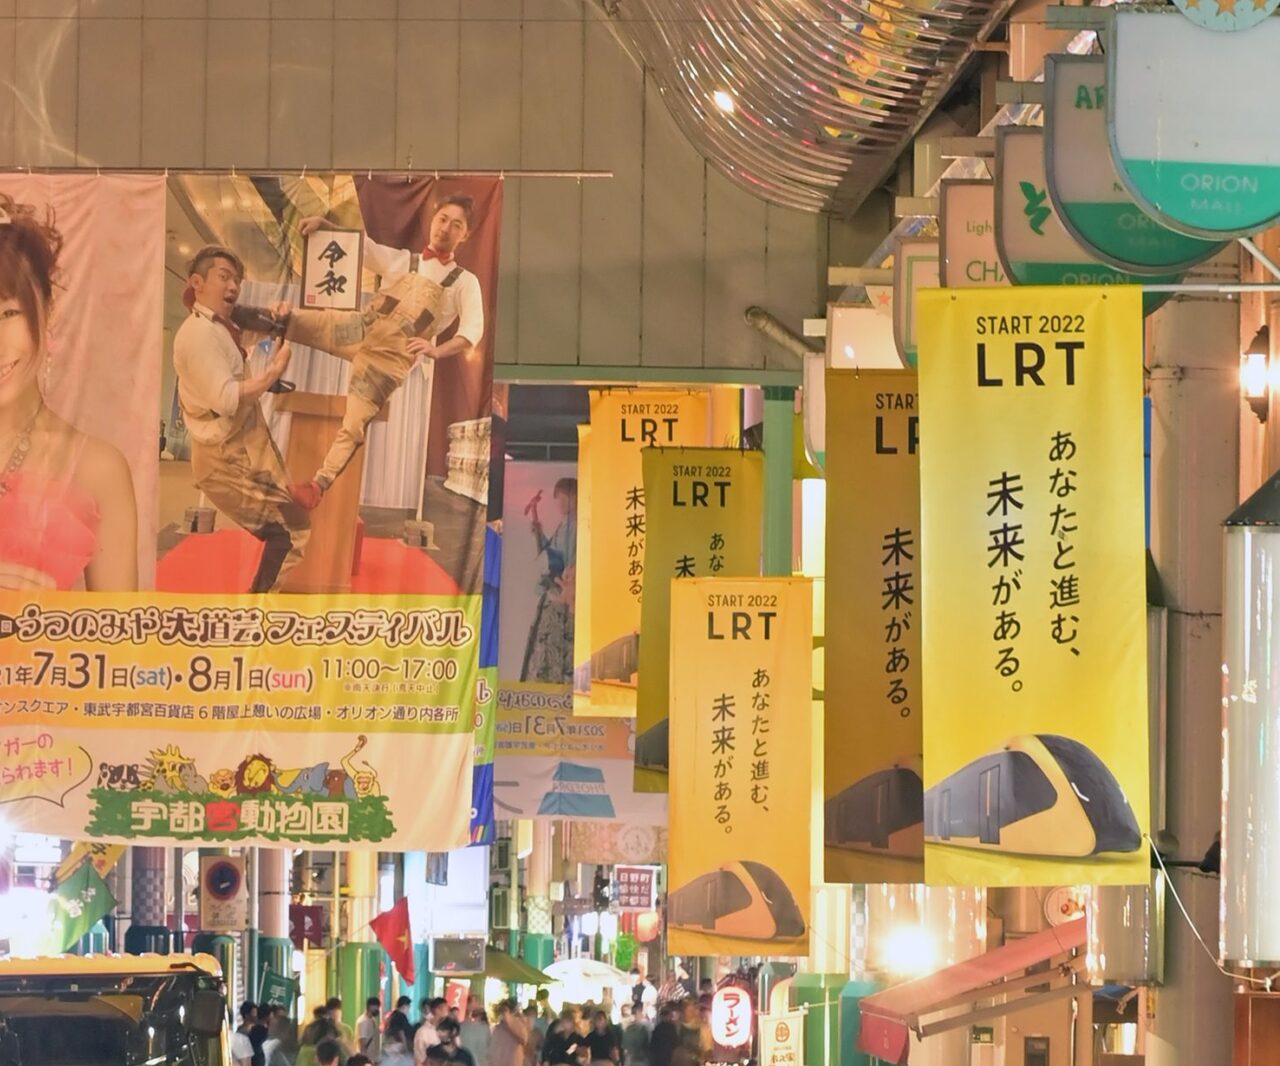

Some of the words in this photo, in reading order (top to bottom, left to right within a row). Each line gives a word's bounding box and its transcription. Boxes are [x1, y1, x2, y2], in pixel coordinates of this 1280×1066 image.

[1180, 173, 1259, 193] ORION
[1190, 198, 1241, 214] MALL
[966, 220, 993, 236] Ligh
[314, 239, 348, 297] 令和
[976, 315, 1033, 336] START
[1038, 314, 1086, 334] 2022
[976, 341, 1086, 388] LRT
[621, 404, 650, 415] START
[654, 404, 679, 415] 2022
[875, 393, 919, 411] STAR
[621, 418, 679, 443] LRT
[672, 465, 703, 478] START
[706, 466, 731, 478] 2022
[672, 481, 731, 508] LRT
[1048, 430, 1081, 657] あなたと進む、
[986, 471, 1025, 693] 未来がある。
[707, 594, 744, 607] START
[747, 594, 778, 607] 2022
[707, 611, 778, 641] LRT
[881, 527, 915, 719] 未来がある。
[750, 667, 771, 813] あなたと進む、
[711, 692, 737, 835] 未来がある。
[131, 800, 349, 836] 宇都宮動物園
[723, 992, 740, 1038] ラーメン
